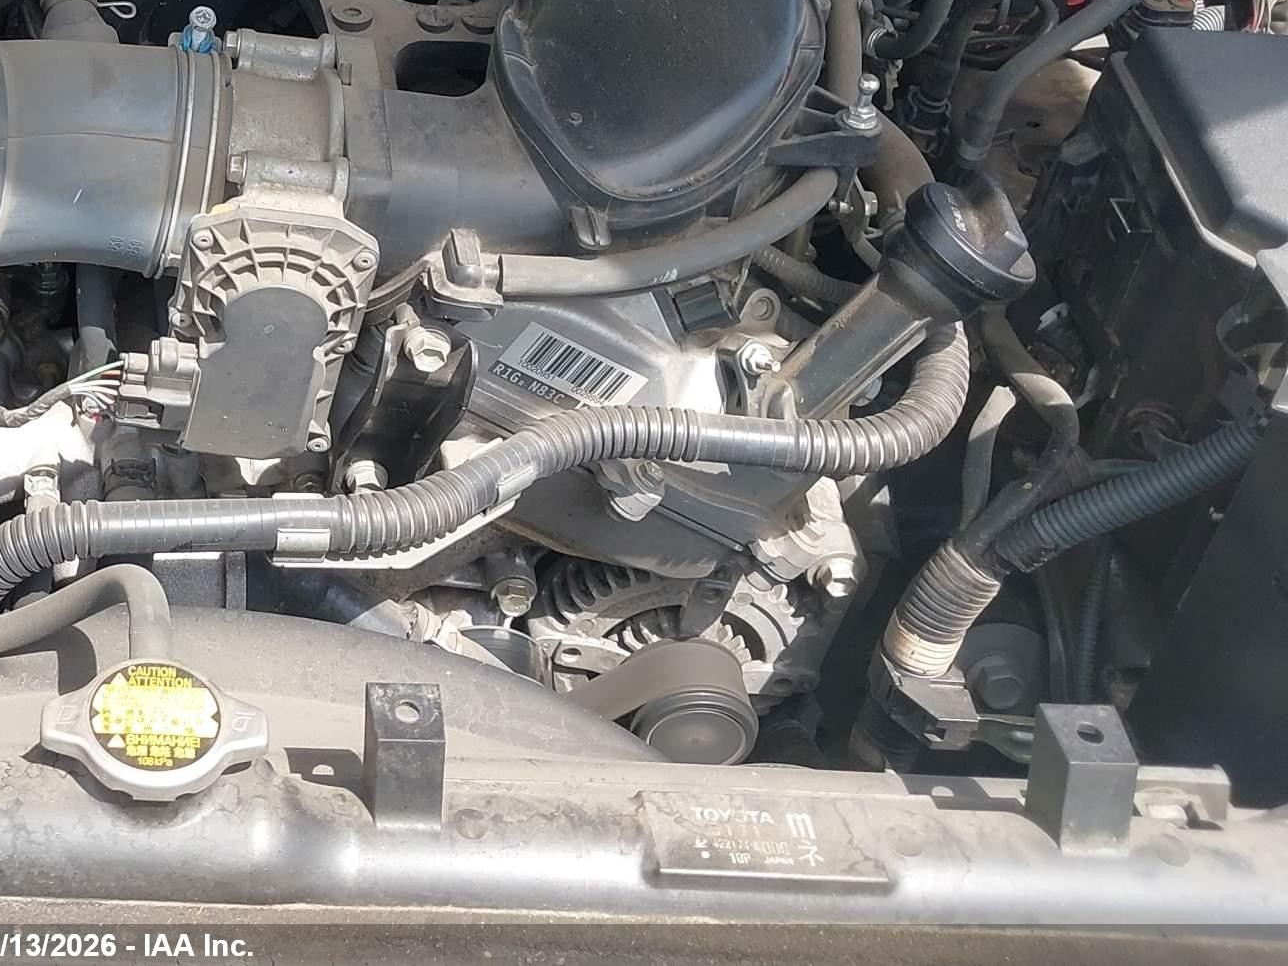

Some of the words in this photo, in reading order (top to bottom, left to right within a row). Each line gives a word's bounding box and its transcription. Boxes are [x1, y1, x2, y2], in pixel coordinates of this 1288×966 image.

[527, 380, 566, 405] N83C
[128, 666, 177, 678] CAUTION
[128, 676, 192, 688] ATTENTION
[125, 734, 201, 748] ВНИМАНИЕ!
